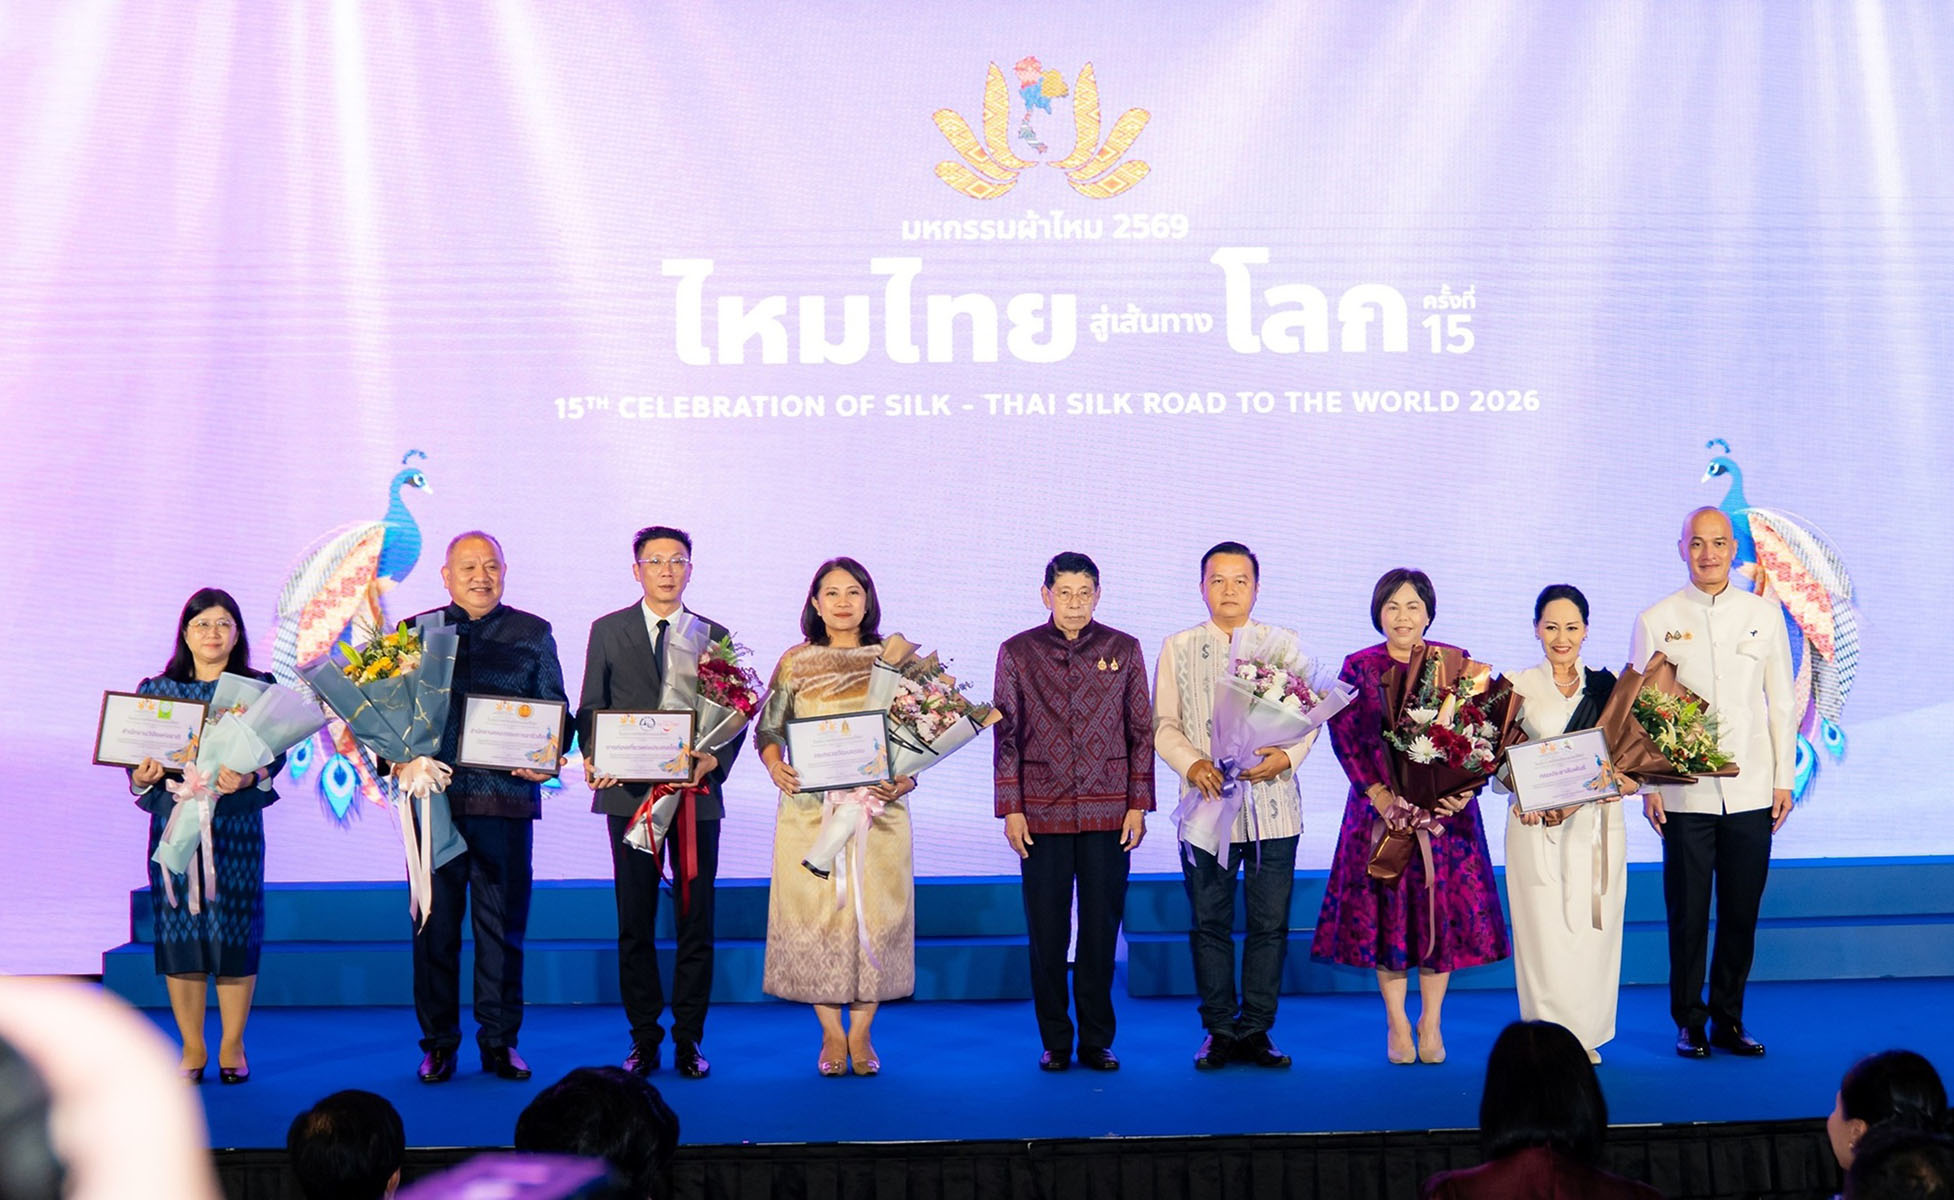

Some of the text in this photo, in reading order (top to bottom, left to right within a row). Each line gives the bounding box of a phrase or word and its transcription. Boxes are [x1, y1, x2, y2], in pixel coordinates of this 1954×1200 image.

[902, 210, 1190, 241] มหกรรมผ้าไหม 2569
[661, 247, 1410, 366] ไหมไทย สู่เส้นทาง โลก
[1422, 284, 1477, 310] ครั้งที่
[1422, 314, 1477, 355] 15
[555, 397, 610, 421] 15TH
[619, 396, 826, 420] CELEBRATION
[836, 395, 876, 418] OF
[885, 394, 953, 418] SILK
[981, 394, 1057, 417] THAI
[1067, 393, 1135, 416] SILK
[1142, 392, 1228, 416] ROAD
[1236, 392, 1277, 415] TO
[1284, 392, 1344, 415] THE
[1352, 391, 1461, 414] WORLD
[1470, 390, 1542, 413] 2026
